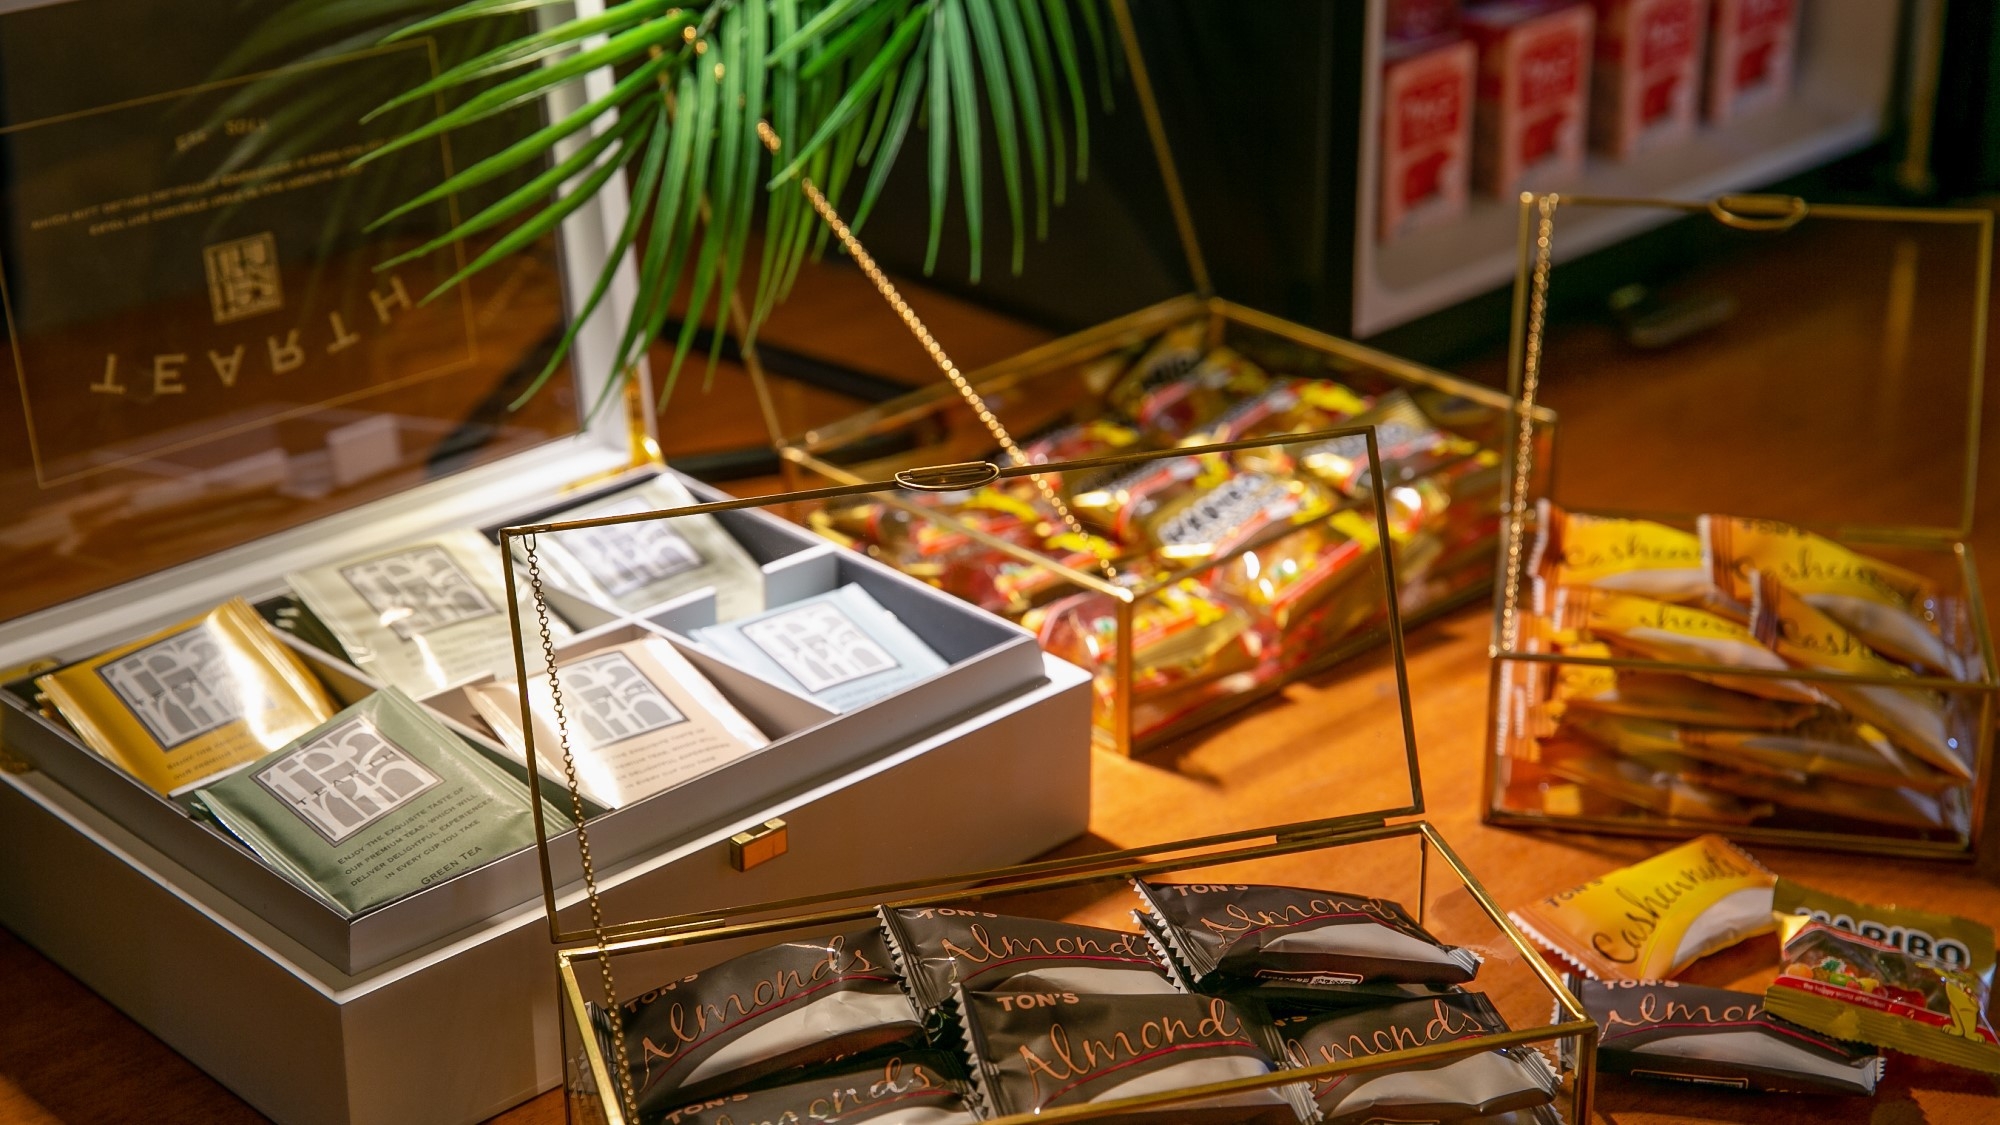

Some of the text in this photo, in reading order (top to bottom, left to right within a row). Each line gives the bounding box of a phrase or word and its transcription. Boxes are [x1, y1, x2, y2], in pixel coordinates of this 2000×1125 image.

[337, 786, 464, 865] ENJOY THE EXQUISITE TASTE OF
[345, 861, 364, 876] OUR
[364, 837, 403, 863] PREMIUM
[428, 805, 457, 824] WHICH
[456, 793, 479, 807] WILL
[350, 797, 494, 887] DELIVER DELIGHTFUL EXPERIENCES
[384, 870, 396, 880] IN
[396, 853, 422, 872] EVERY
[441, 831, 459, 845] YOU
[459, 819, 481, 833] TAKE
[420, 845, 483, 886] GREEN TEA
[917, 907, 998, 920] TON'S
[624, 973, 699, 1013] TON'S
[997, 992, 1080, 1012] TON'S
[1602, 979, 1660, 990] TON'S
[639, 934, 883, 1094] Almonds
[1597, 993, 1776, 1048] Almon
[1287, 998, 1488, 1093] lmonds
[665, 1092, 749, 1124] TON'S
